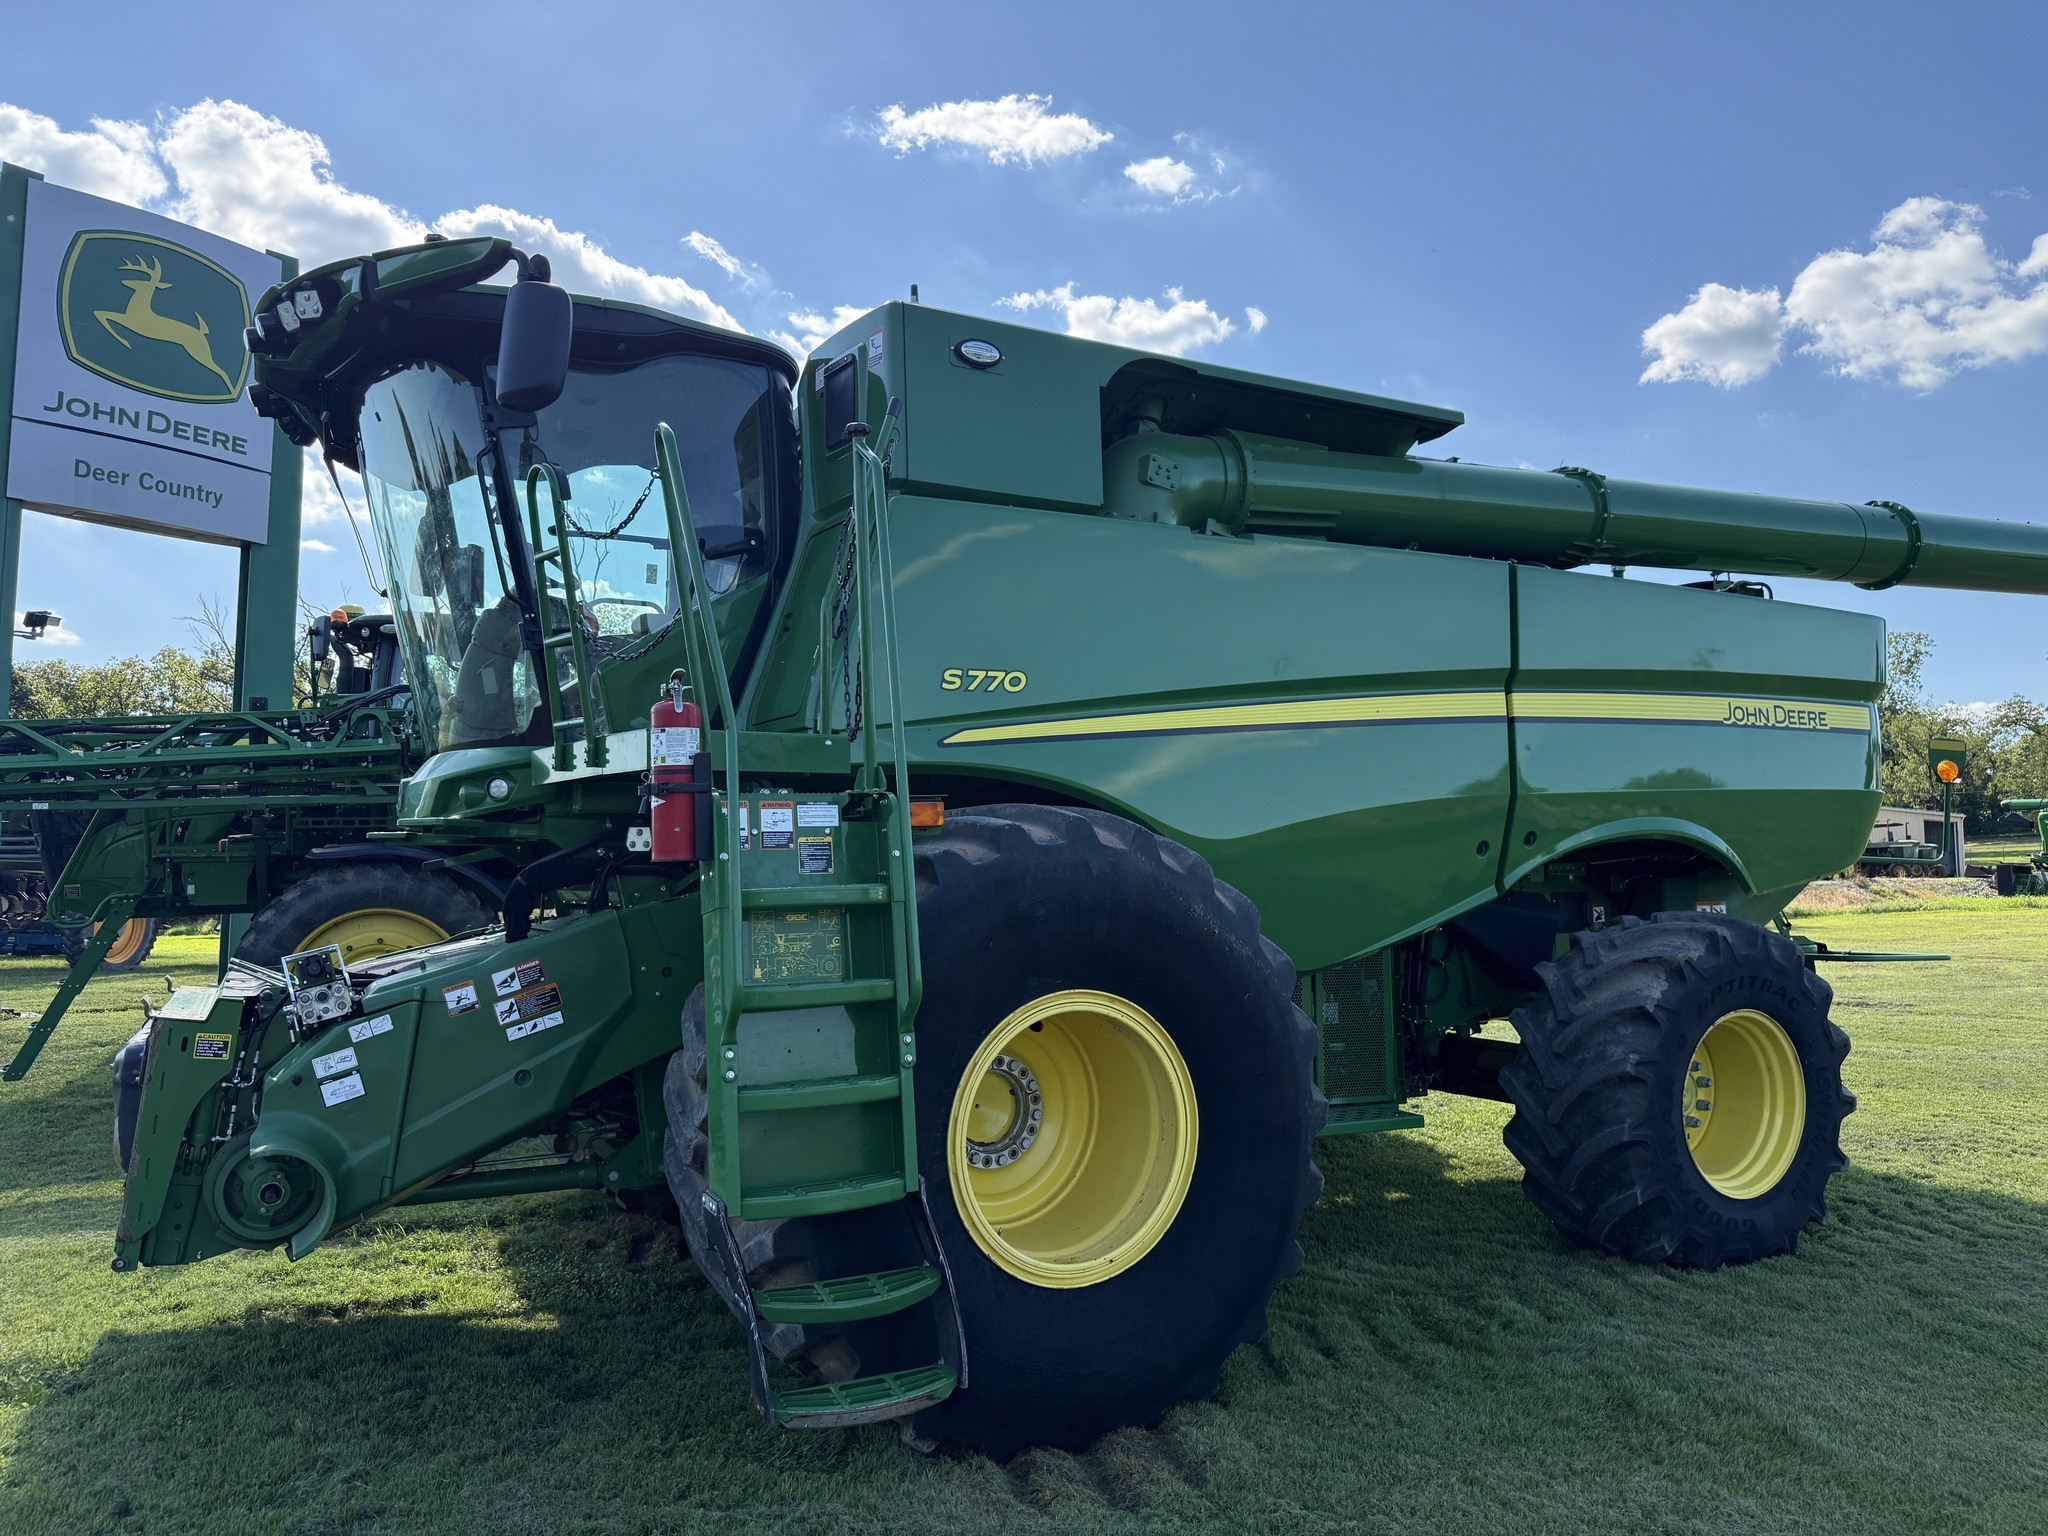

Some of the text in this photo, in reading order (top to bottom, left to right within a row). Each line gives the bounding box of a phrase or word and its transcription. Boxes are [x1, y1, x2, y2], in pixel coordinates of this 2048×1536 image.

[43, 390, 248, 456] JOHN DEERE
[74, 458, 224, 509] Deer Country
[941, 667, 1027, 693] S770
[1722, 701, 1828, 727] JOHN DEERE
[520, 960, 540, 970] DANGER
[1696, 975, 1801, 1018] OPTITRAC
